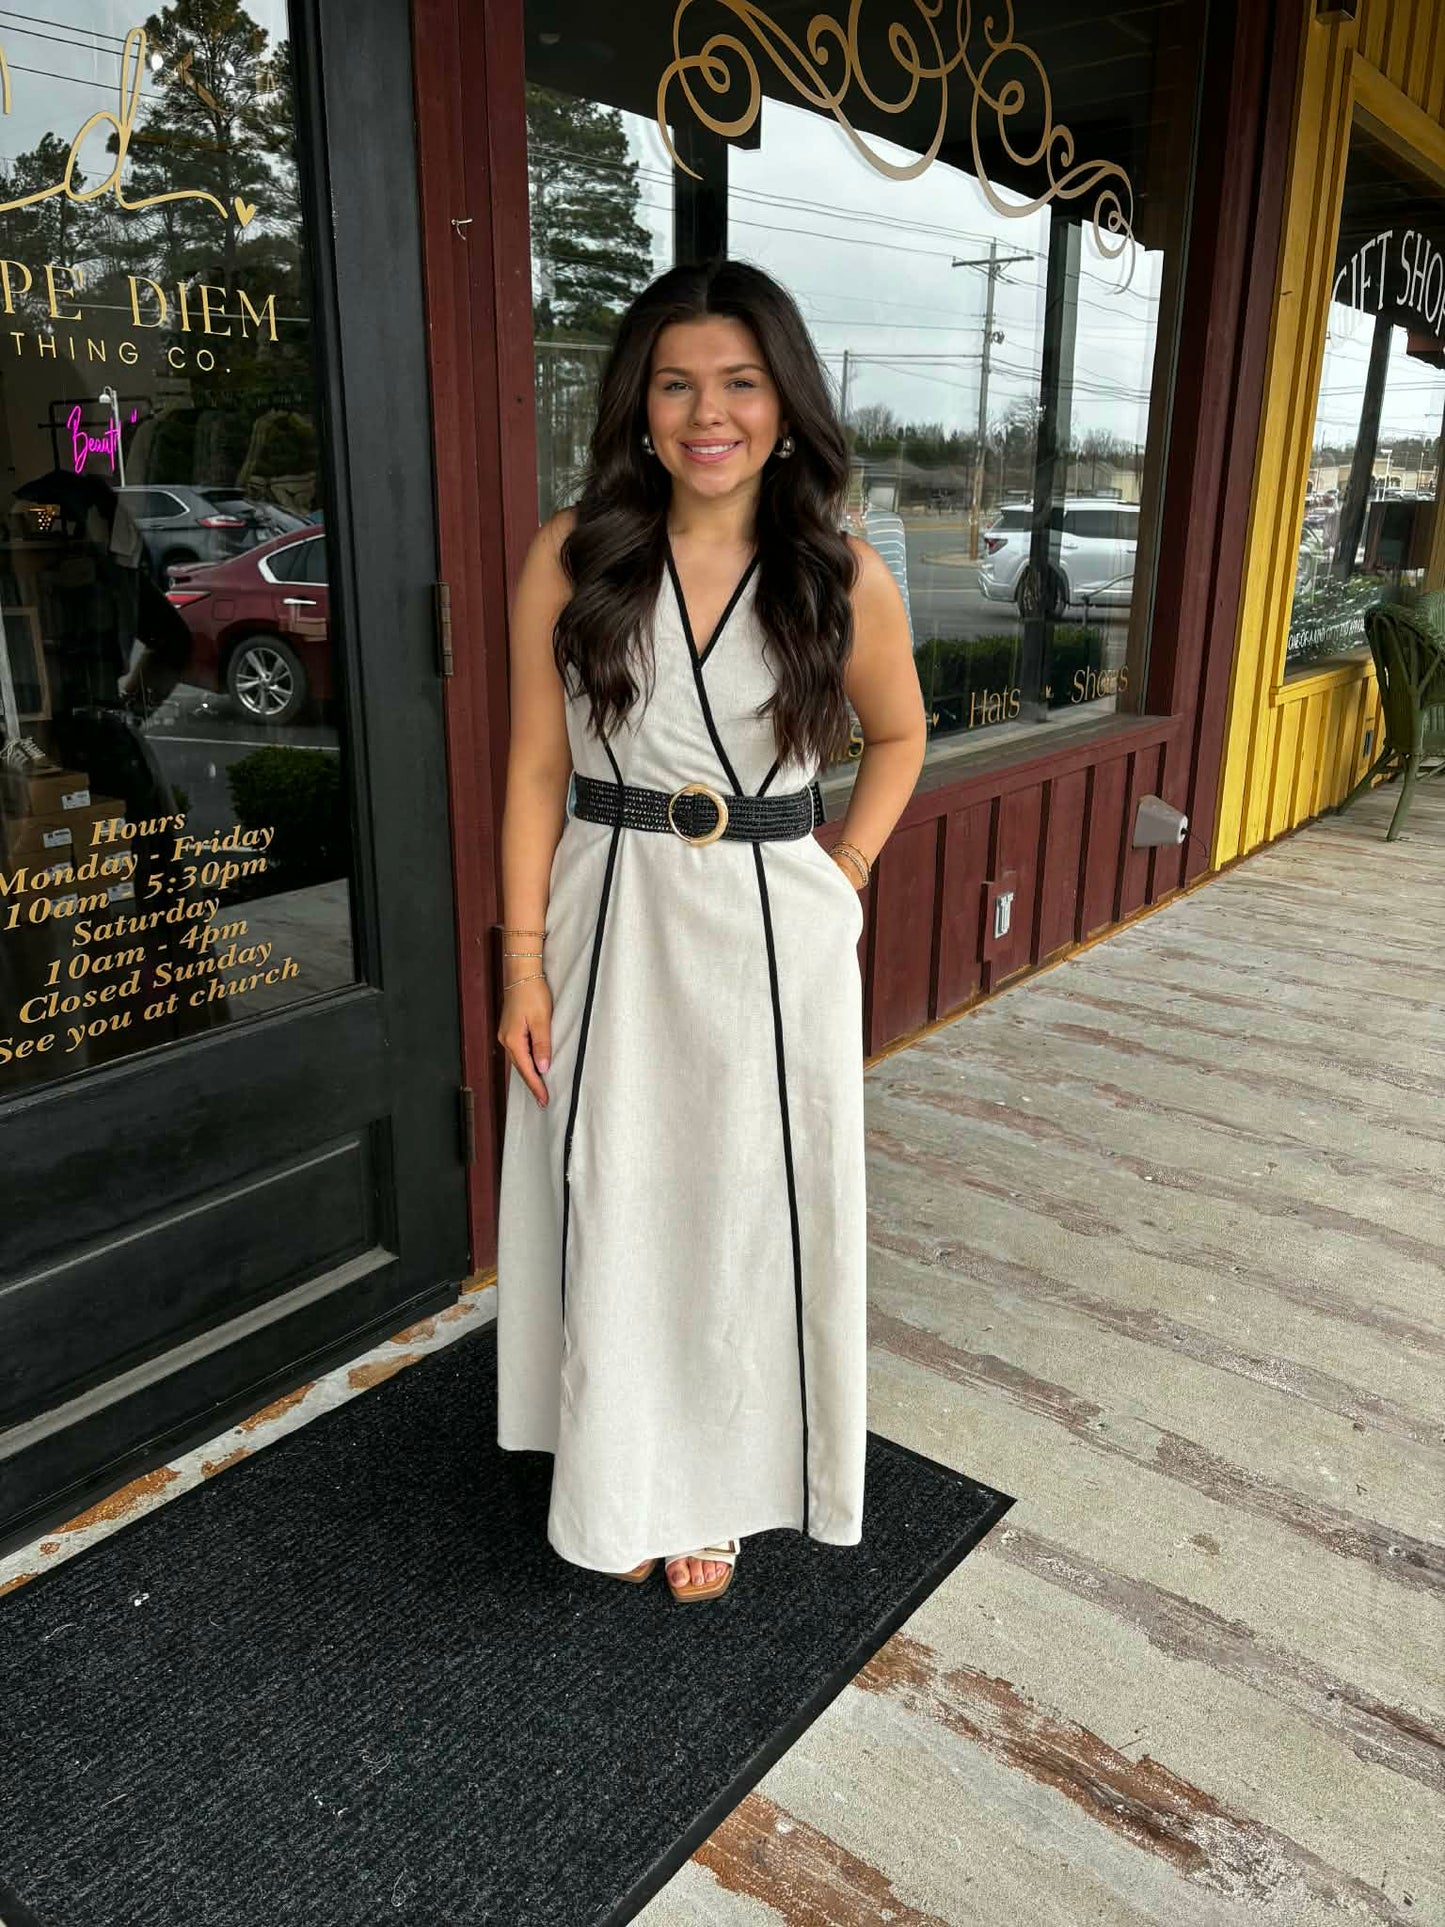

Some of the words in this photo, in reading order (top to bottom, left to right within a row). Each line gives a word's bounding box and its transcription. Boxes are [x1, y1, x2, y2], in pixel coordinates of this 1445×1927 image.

[127, 275, 279, 342] DIEM
[10, 331, 139, 365] THING
[167, 346, 231, 374] CO.
[968, 686, 1021, 729] Hats
[0, 853, 138, 897] Monday
[170, 824, 275, 862] Friday
[89, 813, 187, 846] Hours
[3, 892, 111, 930] 10am
[143, 857, 268, 900] 5:30pm
[72, 897, 220, 947] Saturday
[19, 969, 142, 1024] Closed
[152, 942, 272, 989] Sunday
[43, 946, 146, 987] 10am
[178, 919, 249, 955] 4pm
[0, 1033, 56, 1065] See
[65, 1011, 133, 1053] you
[143, 993, 179, 1021] at
[189, 957, 300, 1007] church
